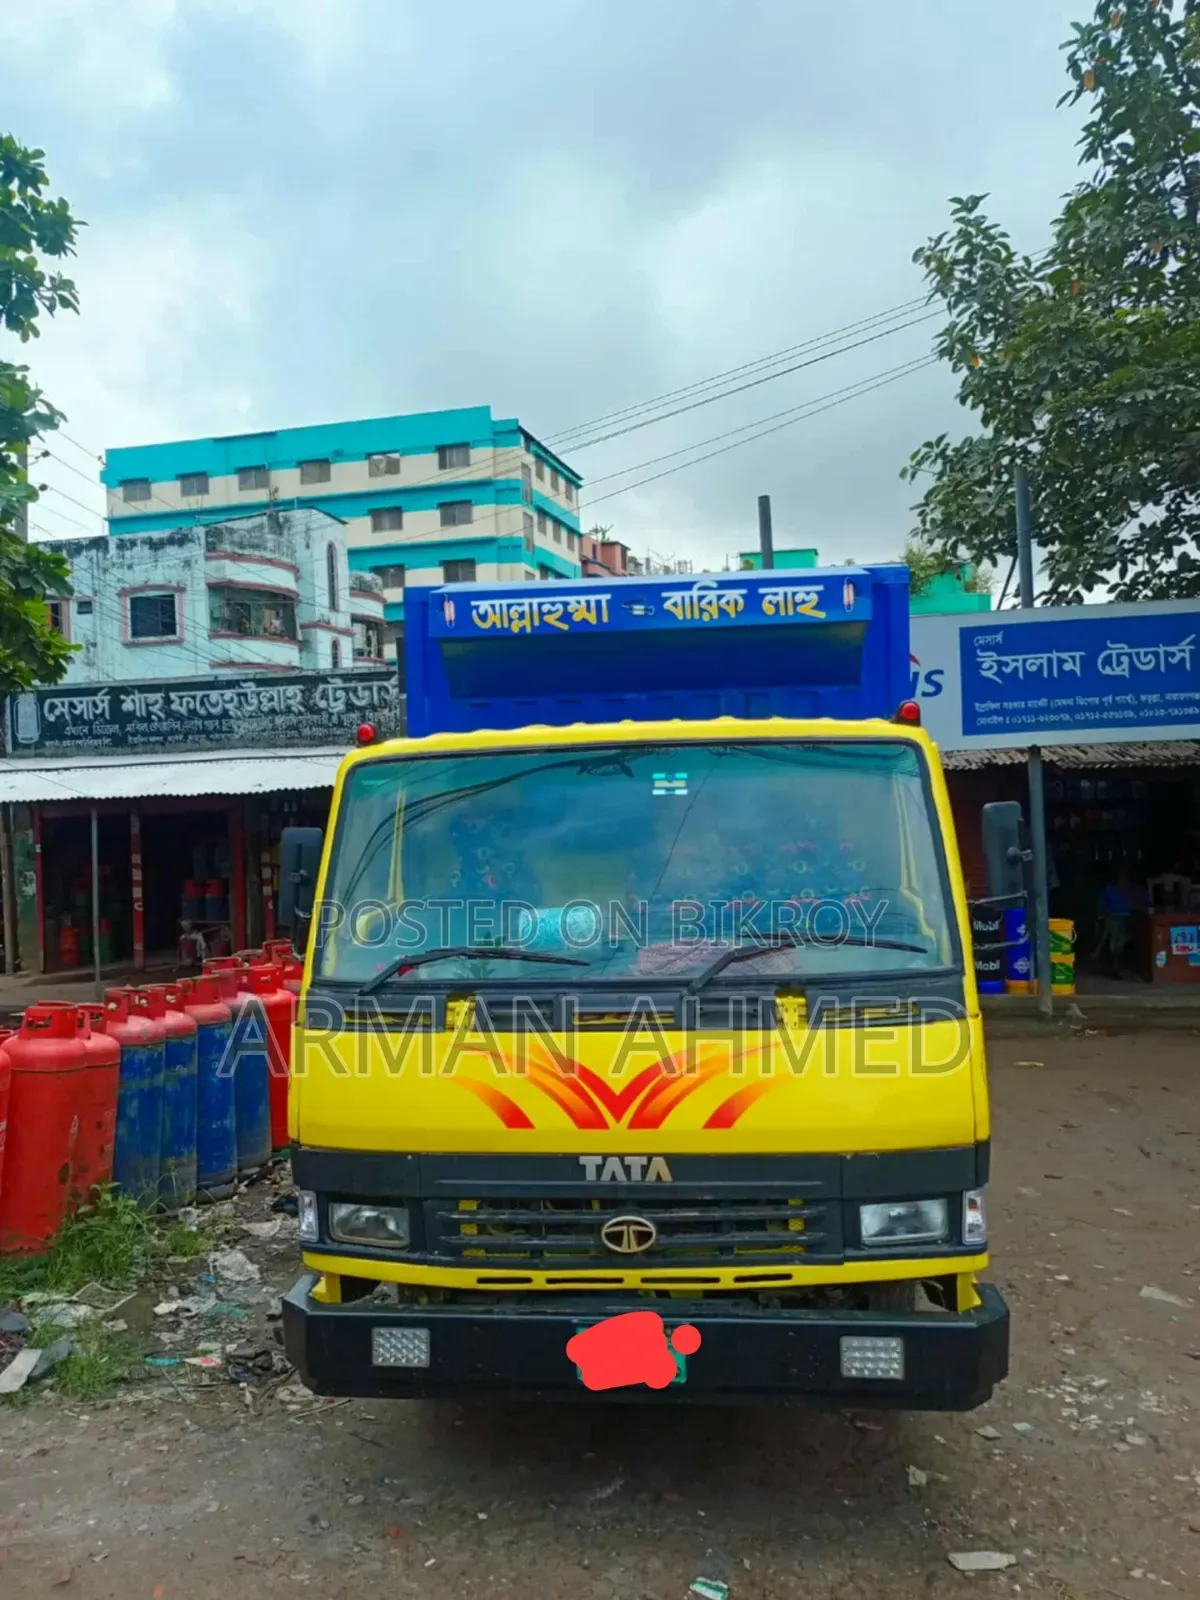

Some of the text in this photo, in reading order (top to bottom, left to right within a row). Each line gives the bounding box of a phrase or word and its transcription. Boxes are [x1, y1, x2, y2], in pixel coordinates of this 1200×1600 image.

[661, 580, 748, 622] বারিক
[758, 585, 826, 618] লাহু
[973, 630, 1004, 647] মেসার্স
[975, 633, 1197, 685] ইসলাম ট্রেডার্স
[43, 687, 112, 723] মেসার্স
[579, 1155, 673, 1182] TATA
